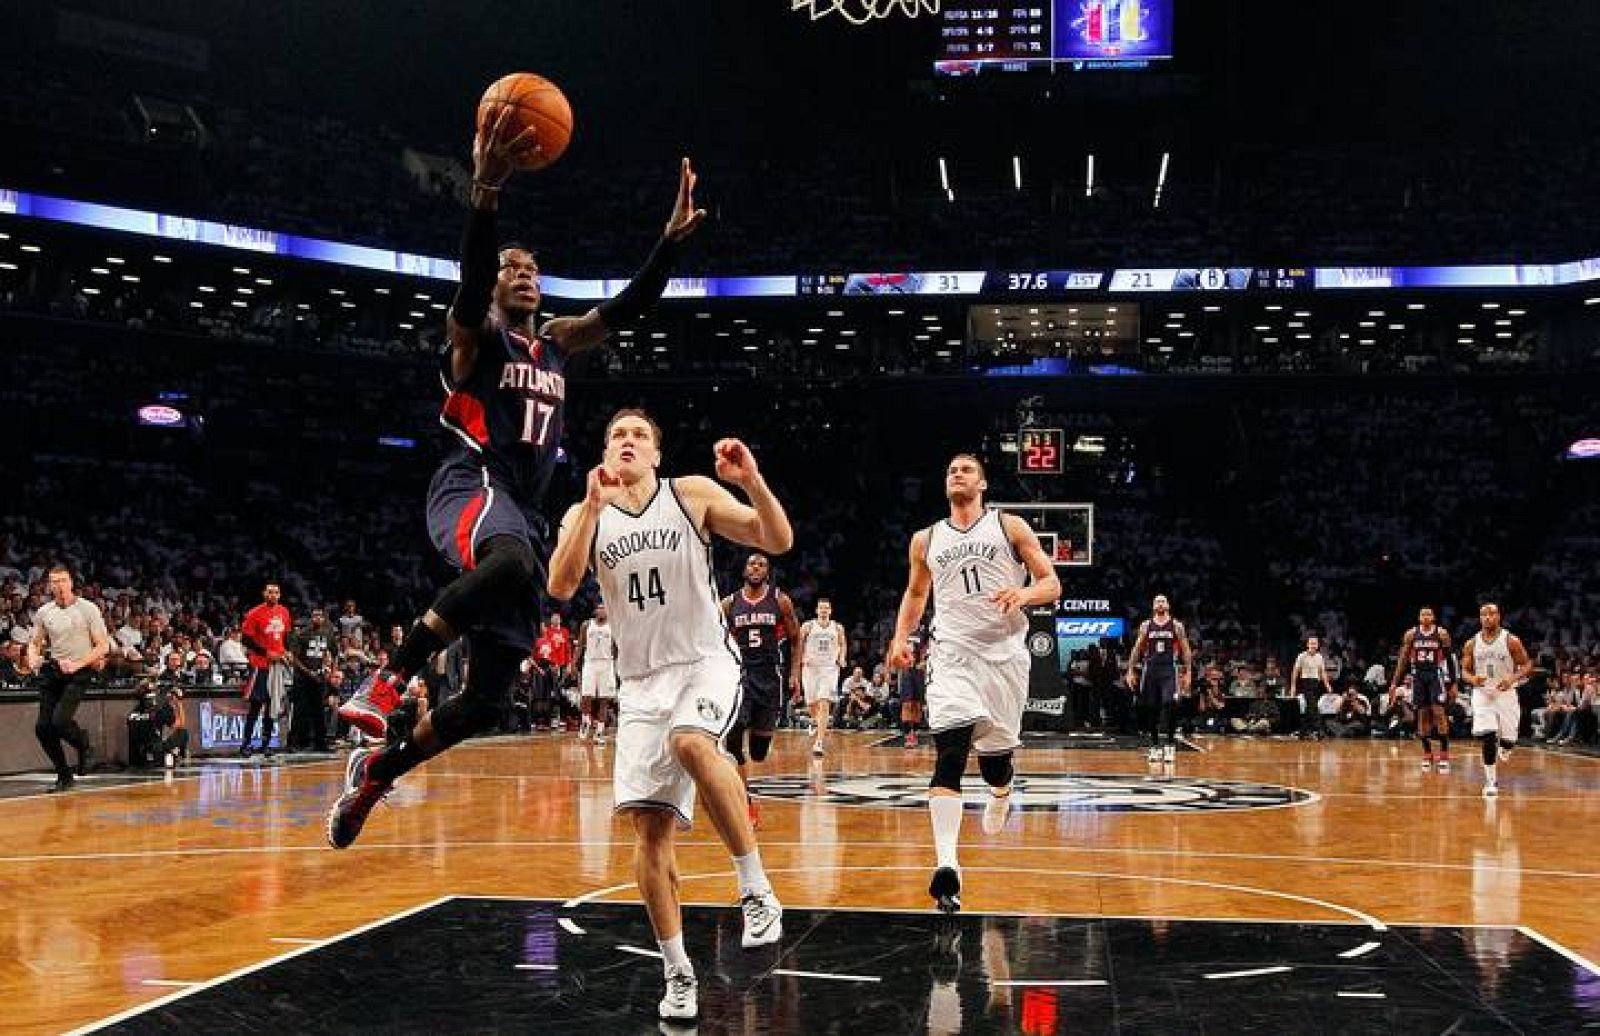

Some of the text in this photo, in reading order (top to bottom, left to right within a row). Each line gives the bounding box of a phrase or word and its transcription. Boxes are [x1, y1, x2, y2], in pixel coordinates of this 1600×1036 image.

[938, 275, 960, 291] 31
[1008, 273, 1048, 290] 37.6
[1074, 275, 1095, 285] 1ST
[1130, 273, 1153, 287] 21
[521, 398, 555, 446] 17
[1027, 446, 1056, 468] 22
[600, 528, 681, 570] BROOKLYN
[936, 541, 998, 568] BROOKLYN
[959, 564, 981, 594] 11
[628, 567, 665, 611] 44
[1063, 599, 1110, 612] CENTER
[735, 613, 776, 628] ATLANTA
[749, 629, 762, 648] 5
